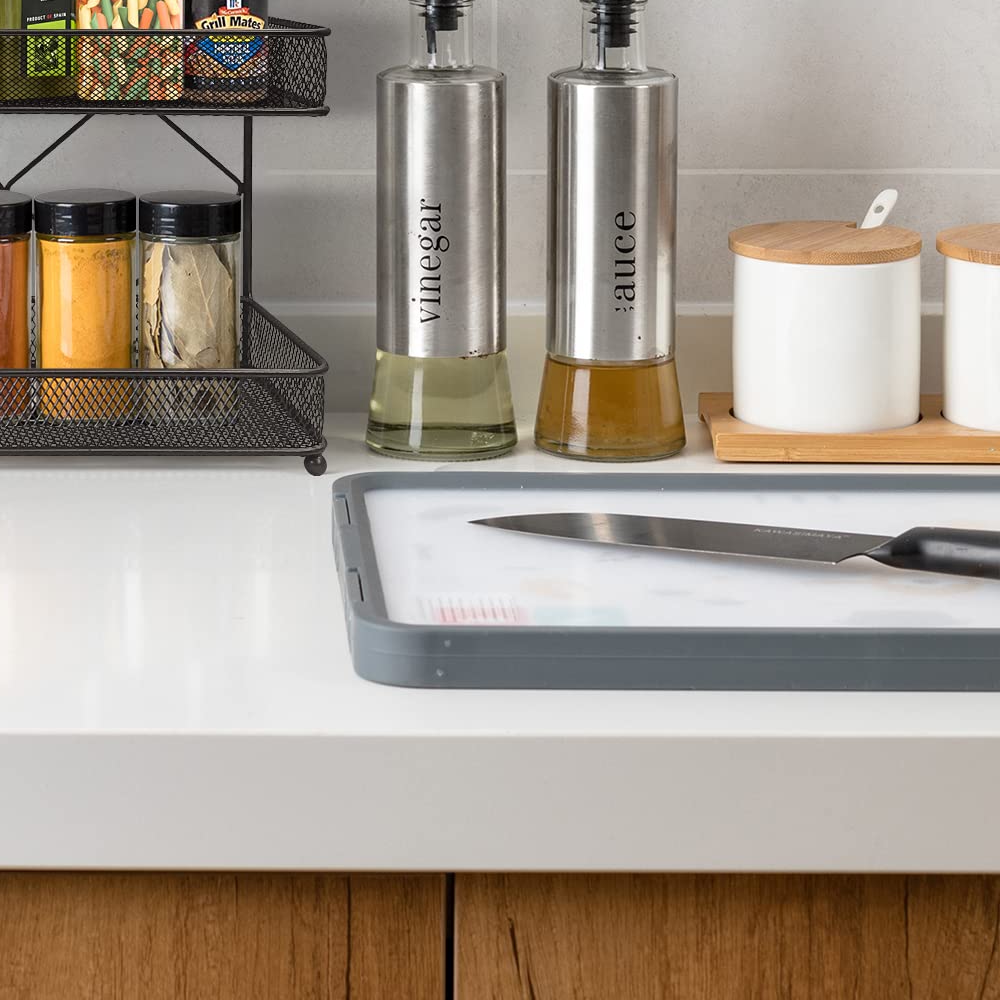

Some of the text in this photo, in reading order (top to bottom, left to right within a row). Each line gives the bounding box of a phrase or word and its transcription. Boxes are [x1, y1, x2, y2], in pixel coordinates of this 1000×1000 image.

[201, 15, 262, 30] Grill Mates
[411, 198, 450, 323] vinegar
[614, 211, 637, 312] auce
